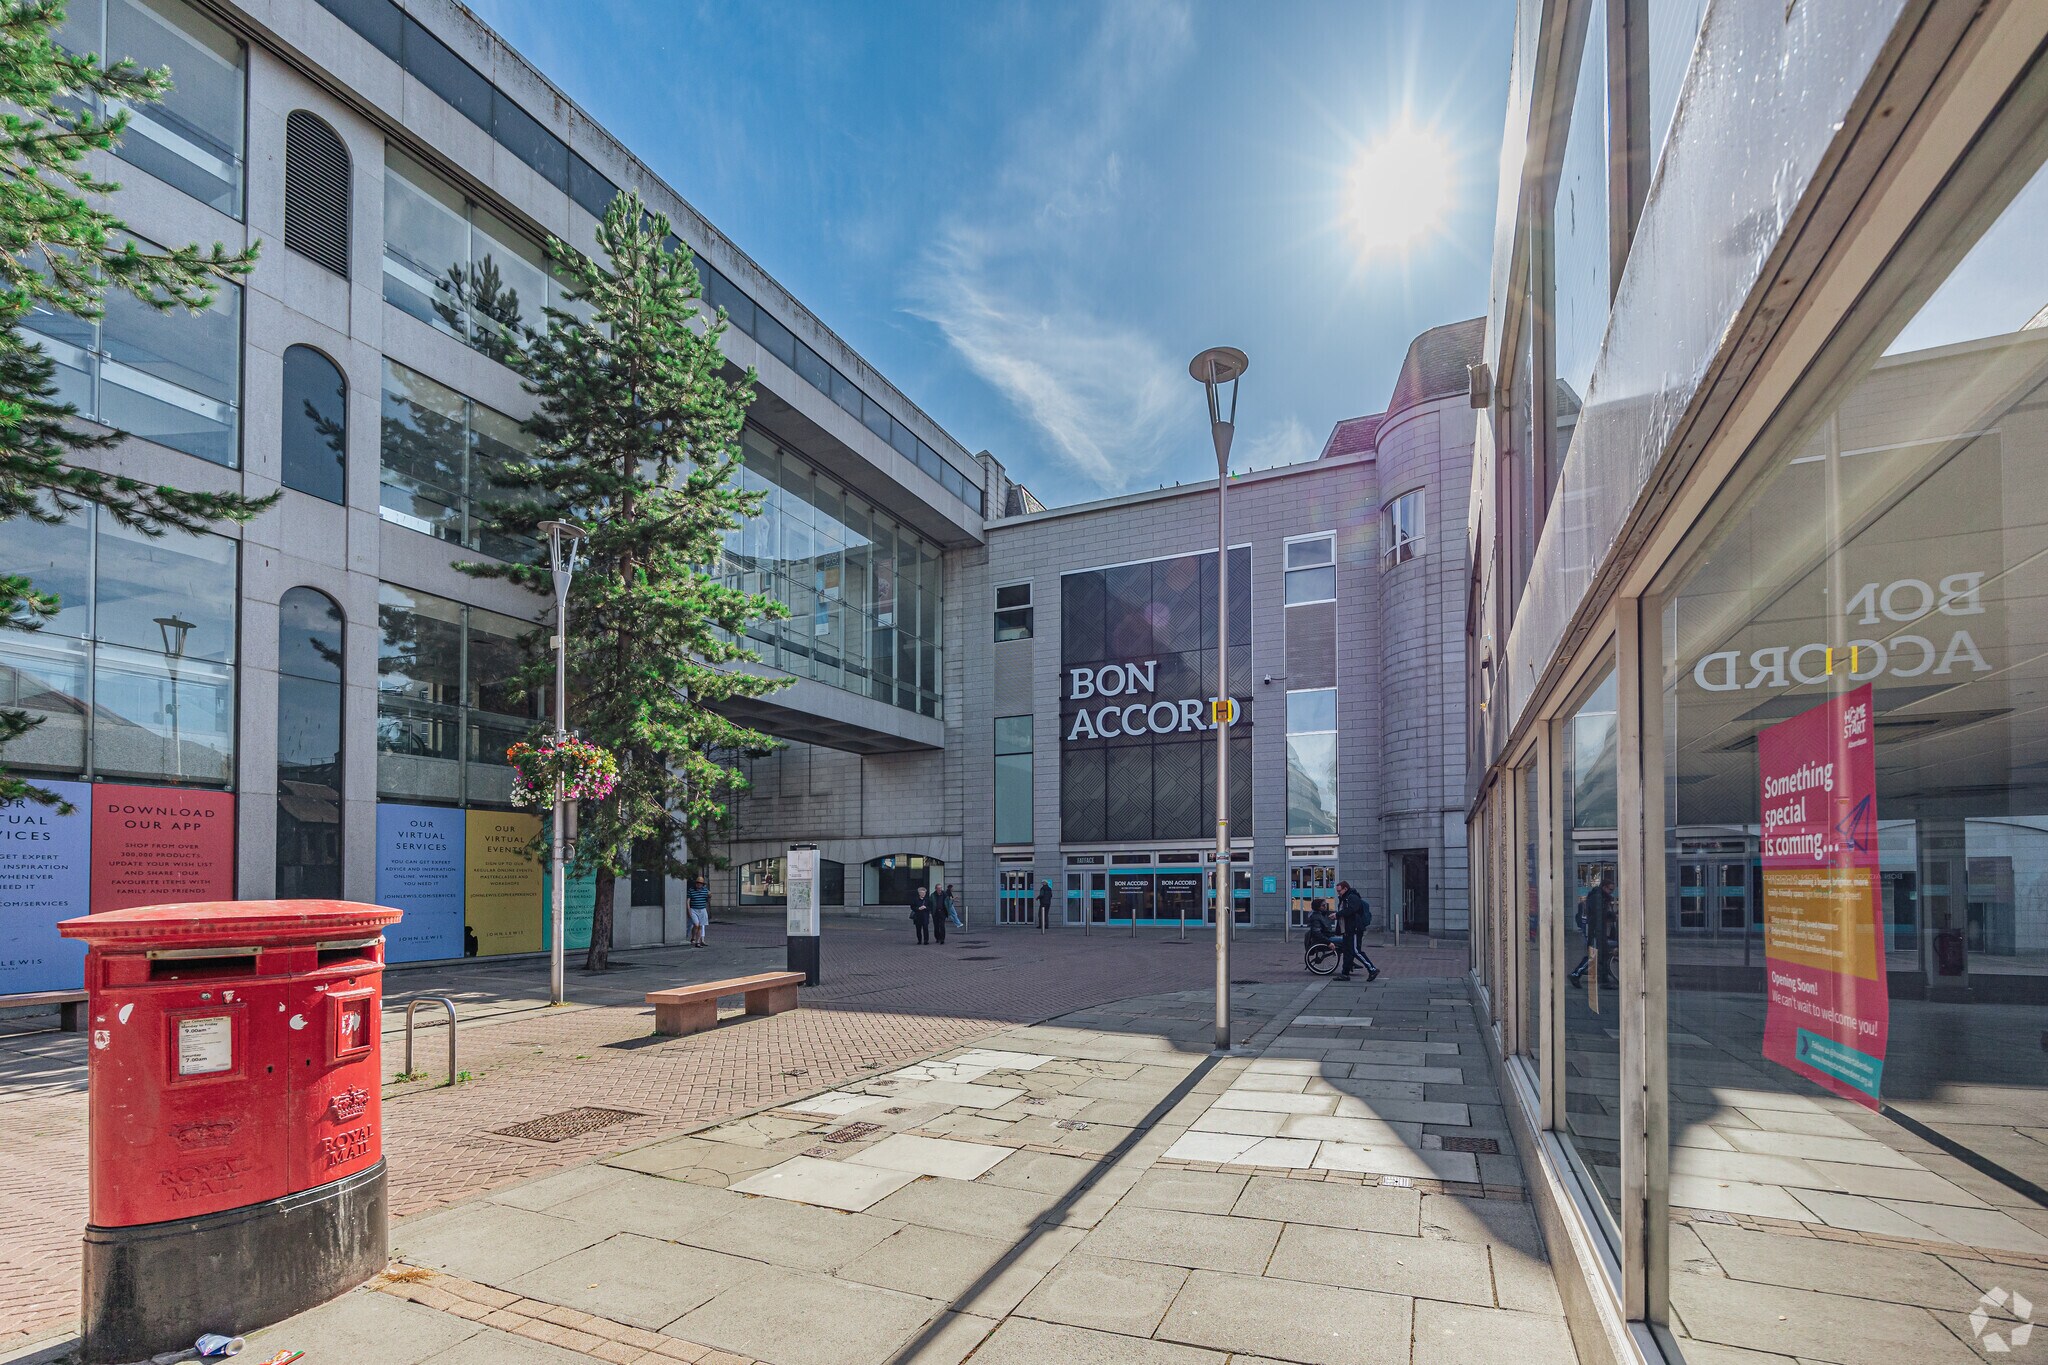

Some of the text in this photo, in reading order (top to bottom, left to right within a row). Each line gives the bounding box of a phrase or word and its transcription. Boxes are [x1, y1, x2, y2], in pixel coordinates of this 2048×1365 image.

[1070, 660, 1157, 700] BON
[1067, 696, 1241, 741] ACCORD
[1844, 703, 1866, 725] HOME
[1844, 719, 1866, 739] START
[1764, 760, 1834, 799] Something
[109, 805, 215, 818] DOWNLOAD
[410, 820, 434, 828] OUR
[1765, 796, 1807, 833] special
[125, 820, 201, 831] OUR APP
[398, 831, 445, 840] VIRTUAL
[396, 842, 447, 851] SERVICES
[1765, 827, 1839, 861] is coming...
[1, 959, 43, 967] LEWIS
[1771, 970, 1818, 996] Opening Soon!
[1772, 990, 1878, 1036] We can't wait to welcome you!
[322, 1123, 374, 1151] ROYAL
[329, 1141, 371, 1167] MAIL
[157, 1156, 251, 1187] ROYAL
[168, 1177, 245, 1202] MAIL
